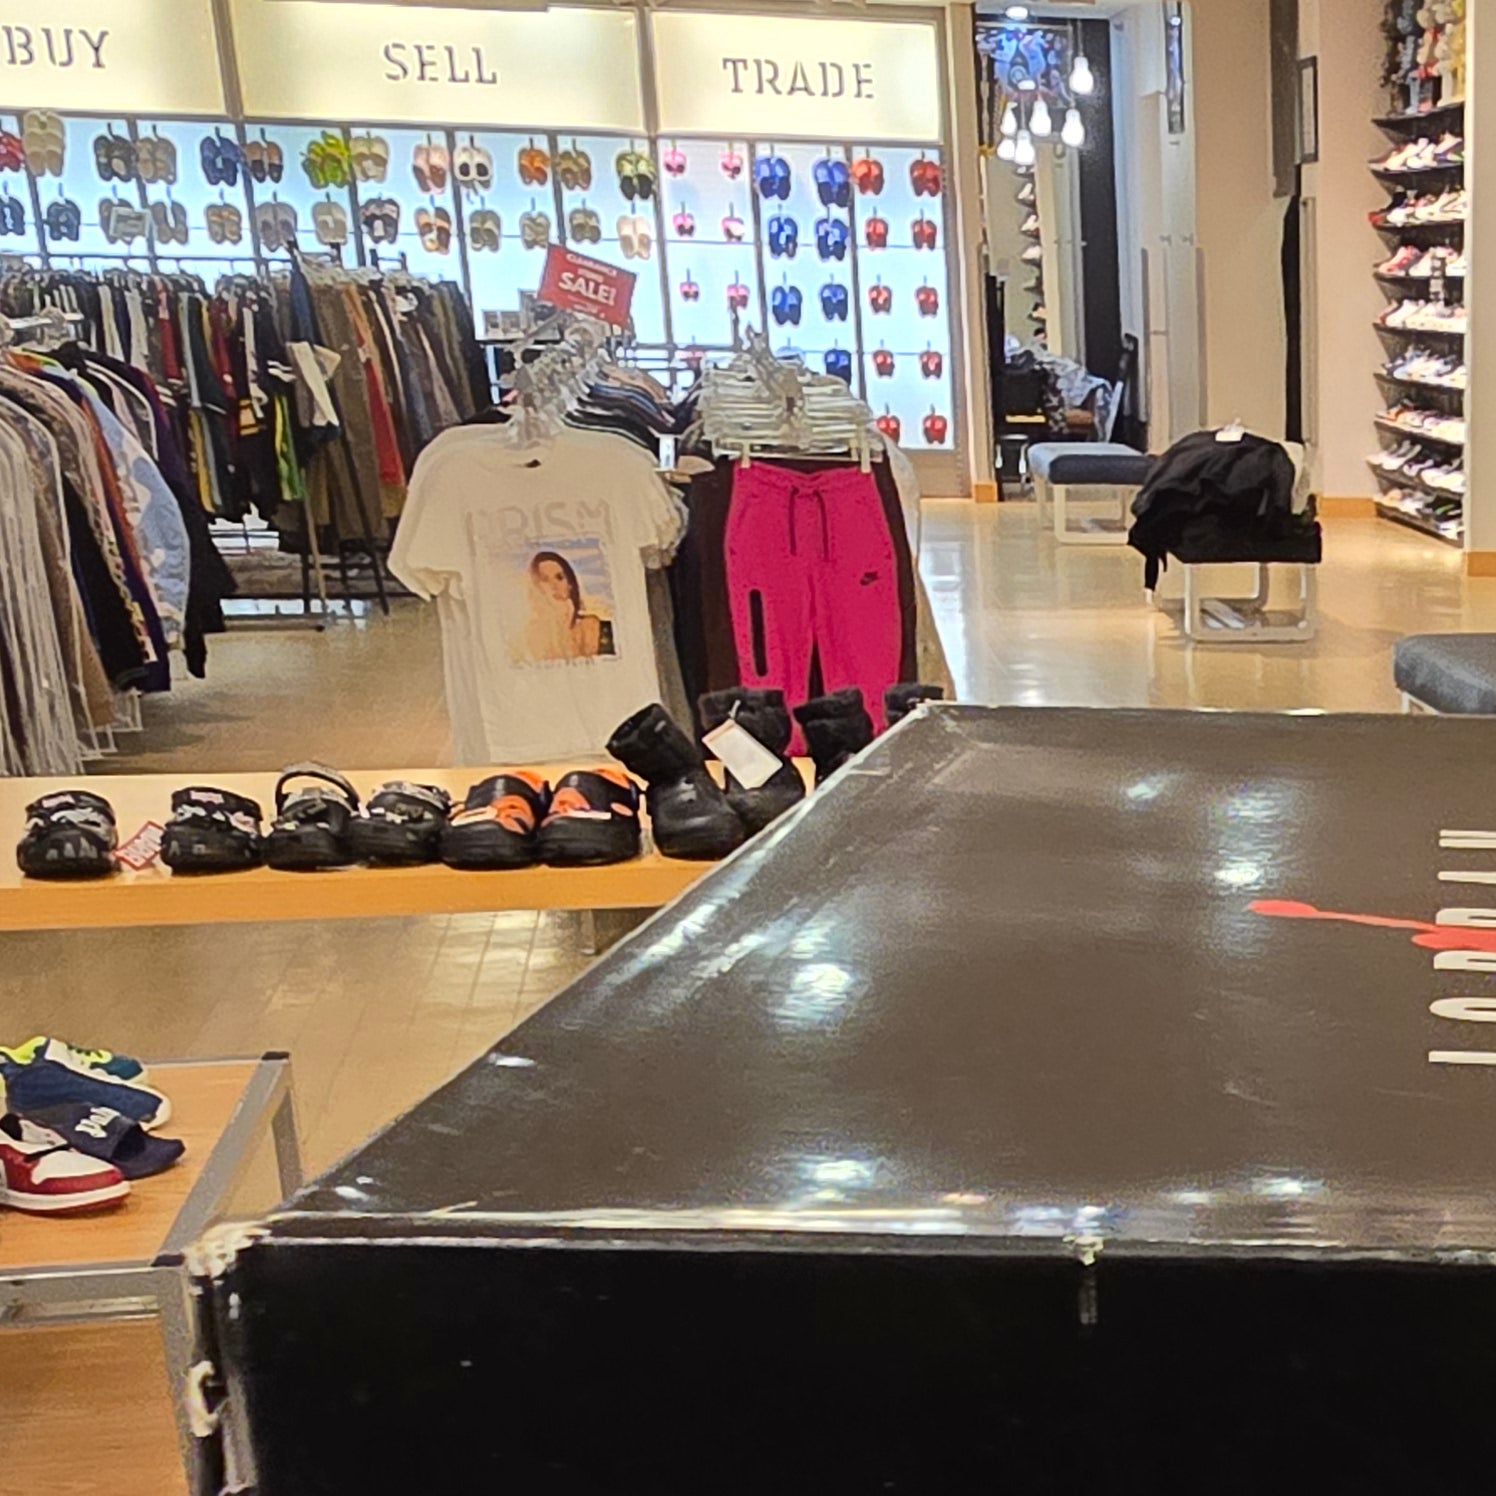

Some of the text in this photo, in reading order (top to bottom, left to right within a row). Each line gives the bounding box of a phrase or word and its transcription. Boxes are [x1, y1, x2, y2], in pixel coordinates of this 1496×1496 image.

[1, 25, 109, 69] BUY
[383, 42, 498, 85] SELL
[722, 57, 876, 100] TRADE
